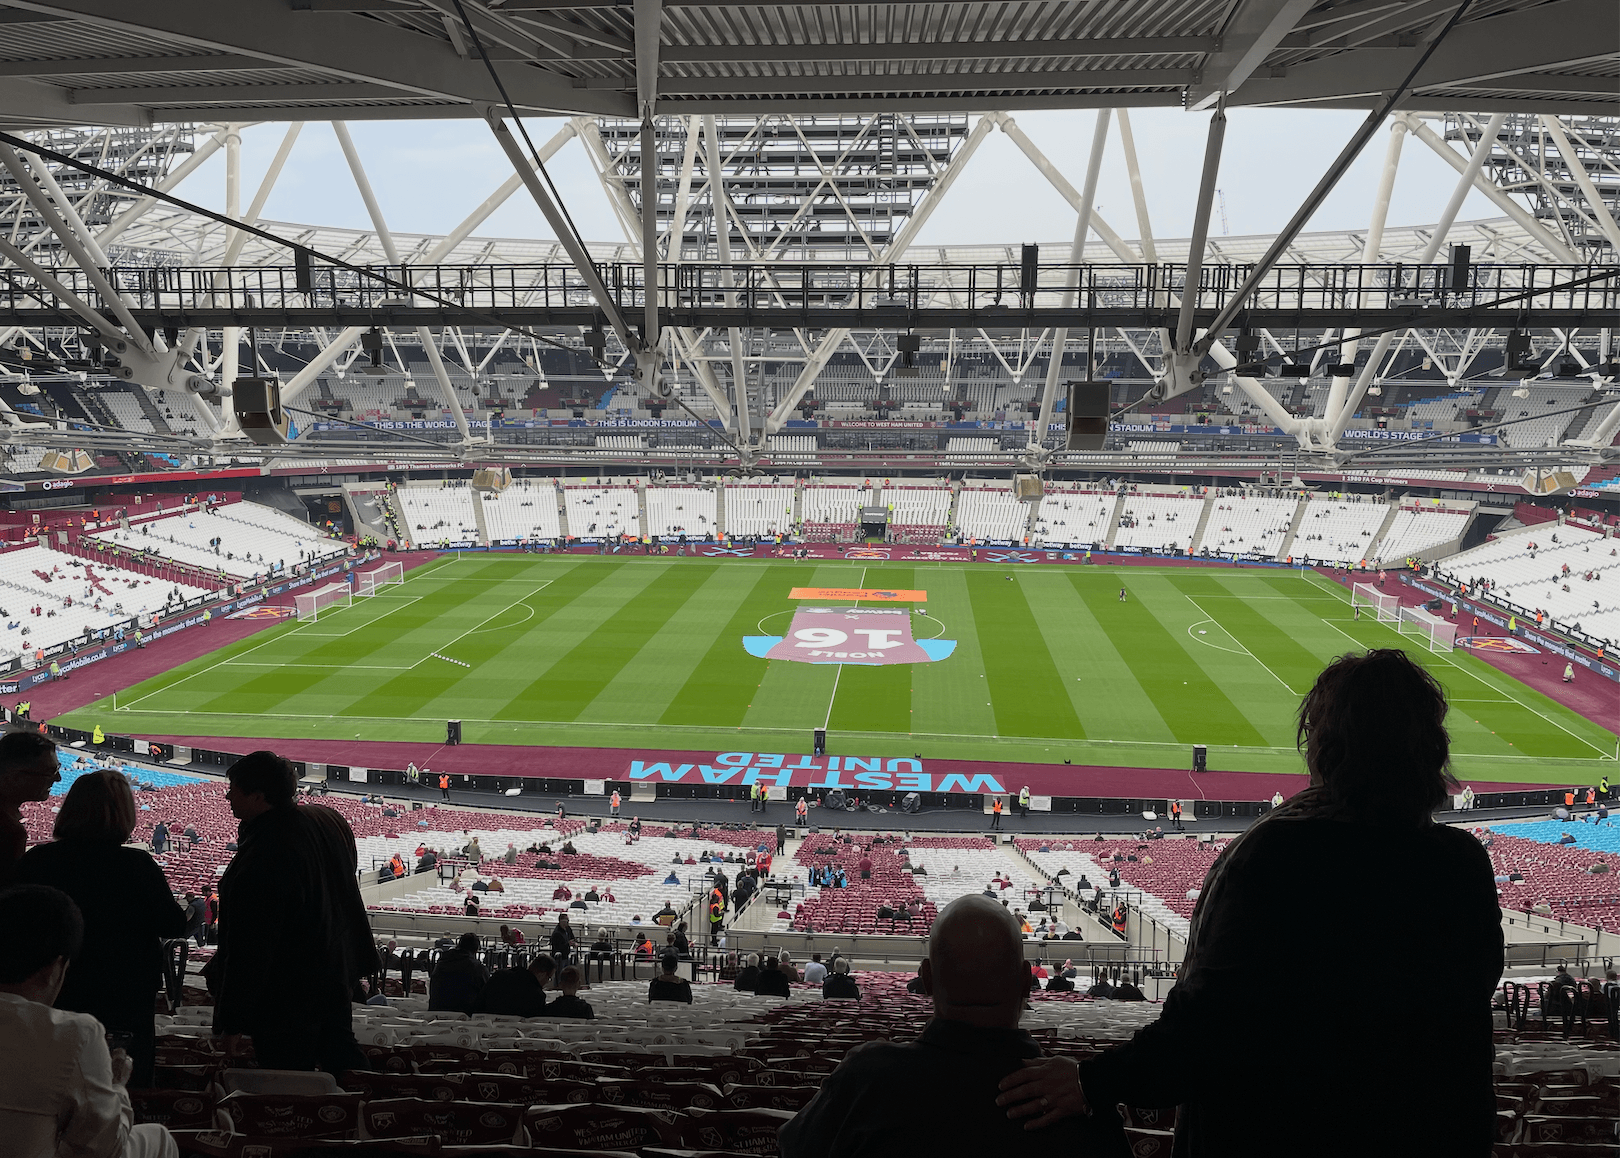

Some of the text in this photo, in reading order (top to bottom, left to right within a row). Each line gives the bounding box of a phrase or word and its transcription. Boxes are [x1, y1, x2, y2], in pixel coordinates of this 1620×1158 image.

[1345, 430, 1423, 440] WORLD'S STAGE
[153, 631, 162, 639] the
[162, 622, 185, 636] moments
[186, 617, 196, 627] that
[794, 628, 904, 649] 16
[44, 645, 64, 656] betway
[113, 643, 124, 653] Lyca
[807, 650, 885, 658] NOBLE
[1524, 630, 1536, 642] Share
[1545, 640, 1564, 655] moments
[1565, 648, 1574, 659] that
[1575, 655, 1591, 667] matter
[59, 650, 107, 676] ycaMobile.co.uk
[1600, 664, 1611, 675] Lyca
[32, 673, 45, 683] Lyca
[716, 752, 924, 772] UNITED
[629, 760, 793, 787] HAM
[808, 772, 1006, 794] WEST
[574, 1129, 592, 1137] WES
